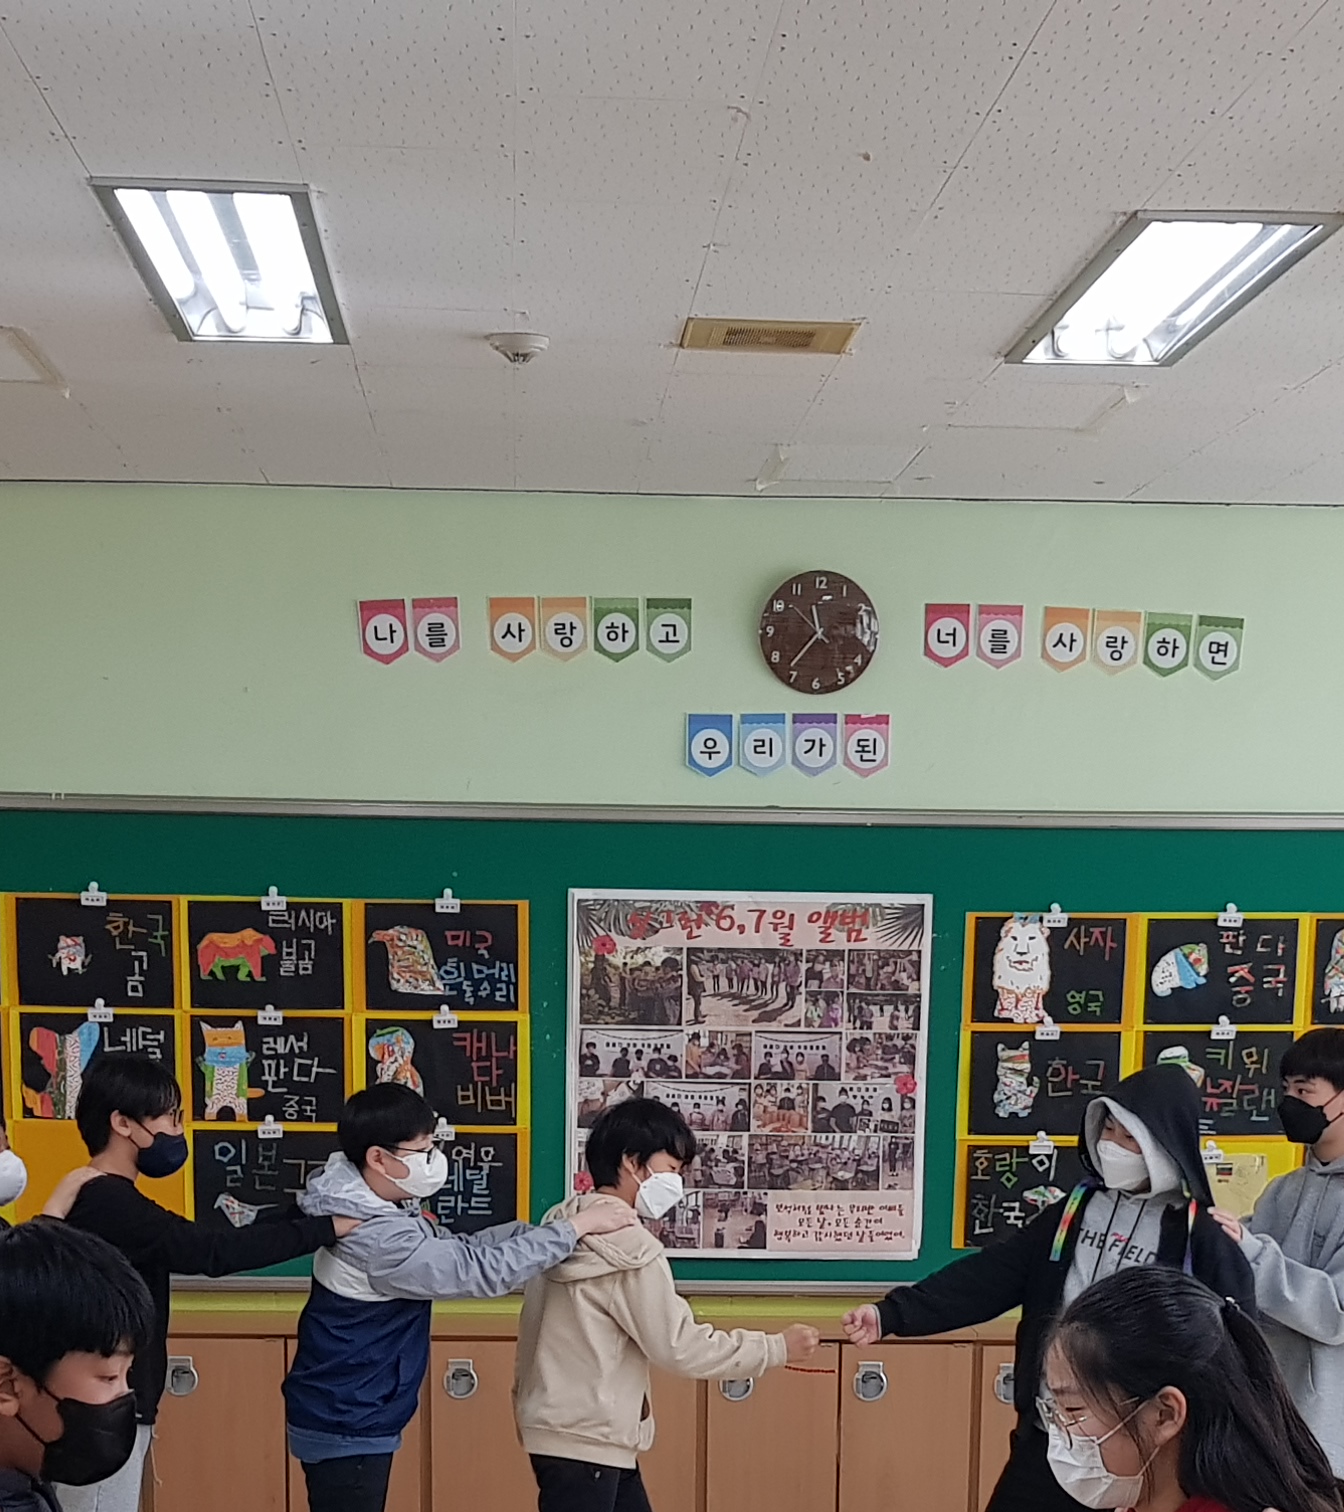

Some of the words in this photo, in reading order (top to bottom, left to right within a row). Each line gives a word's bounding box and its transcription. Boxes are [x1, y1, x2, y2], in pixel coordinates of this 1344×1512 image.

[792, 583, 802, 595] 11
[816, 577, 827, 589] 12
[842, 585, 847, 597] 1
[773, 600, 784, 612] 10
[373, 622, 448, 648] 나를
[501, 621, 681, 648] 사랑하고
[766, 626, 774, 637] 9
[771, 651, 780, 663] 8
[854, 654, 862, 666] 4
[936, 627, 1010, 654] 너를
[1052, 632, 1229, 666] 사랑하면
[789, 671, 797, 683] 7
[812, 678, 820, 689] 6
[836, 671, 845, 685] 5
[105, 912, 170, 957] 한국
[268, 909, 337, 936] 러시아
[807, 909, 870, 944] 앨범
[280, 938, 316, 977] 불곰
[444, 930, 493, 959] 미국
[1064, 925, 1118, 961] 사자
[126, 951, 148, 997] 곰
[1227, 962, 1288, 1008] 중국
[1066, 989, 1105, 1016] 영국
[452, 1029, 517, 1061] 캐나
[260, 1057, 338, 1093] 판다
[471, 1057, 503, 1087] 다
[282, 1095, 317, 1123] 중국
[457, 1081, 516, 1118] 비버
[213, 1138, 279, 1191] 일본
[970, 1147, 1058, 1189] 호랑이
[437, 1195, 493, 1224] 란드
[971, 1194, 1026, 1235] 한국
